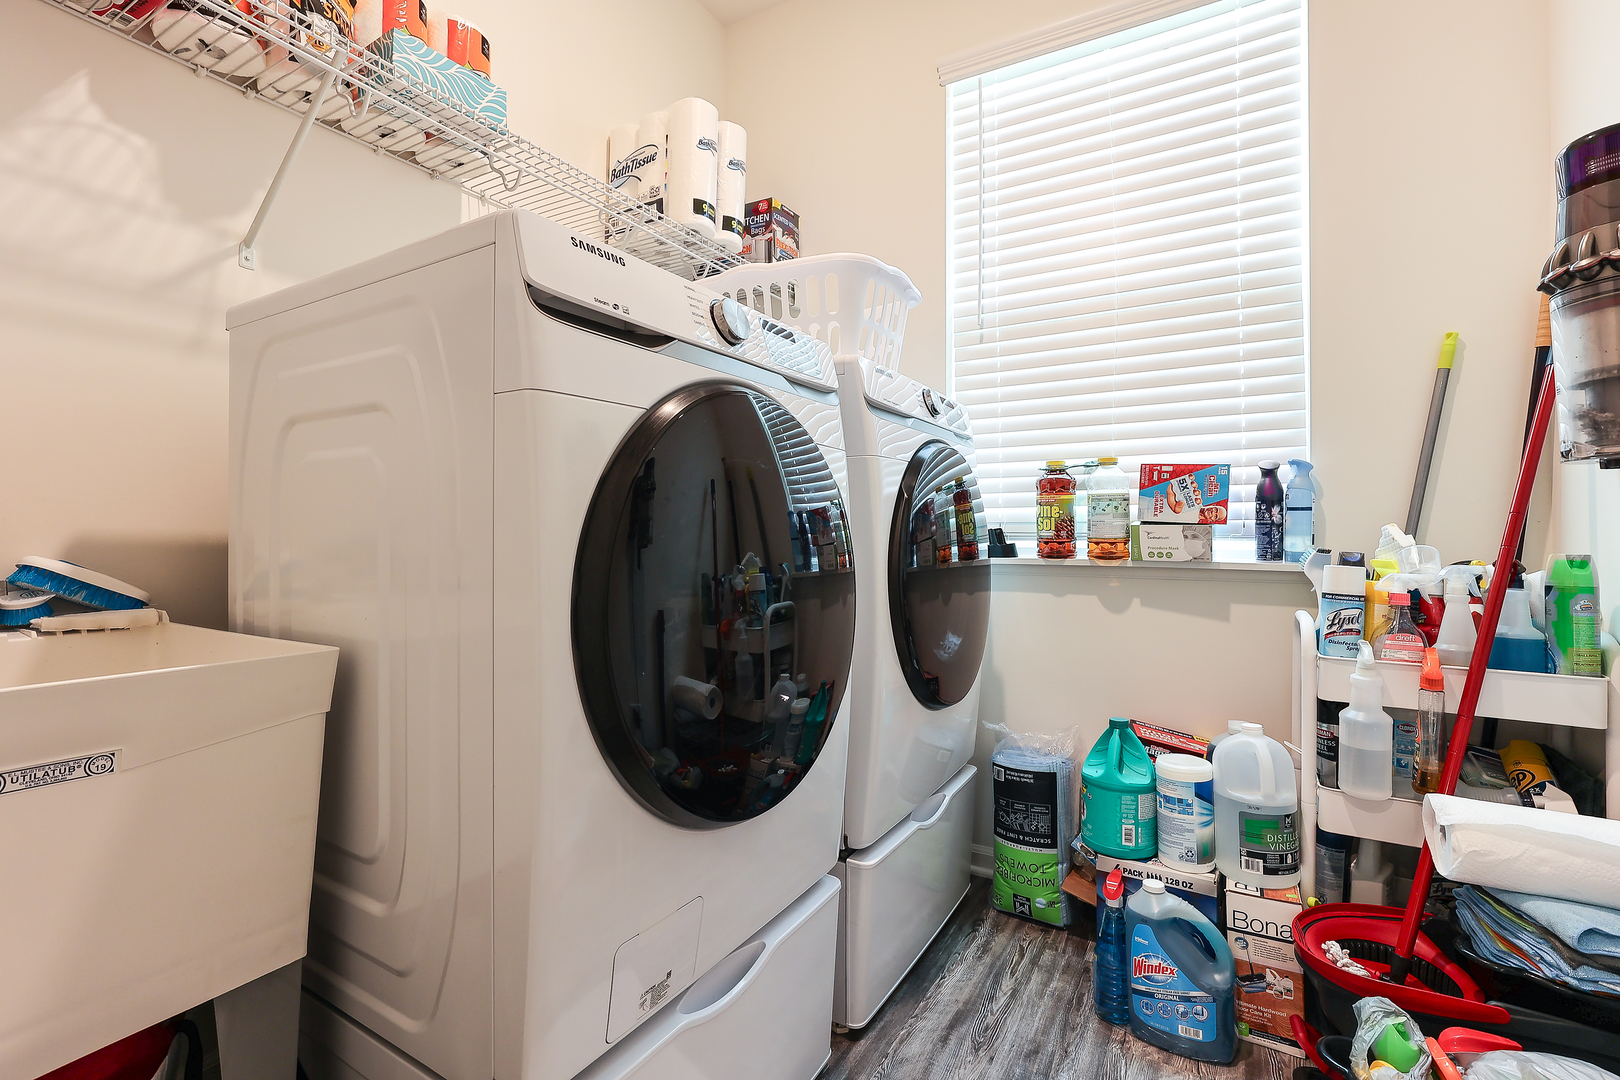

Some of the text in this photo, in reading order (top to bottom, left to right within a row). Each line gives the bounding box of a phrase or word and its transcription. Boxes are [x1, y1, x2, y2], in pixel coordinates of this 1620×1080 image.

[745, 213, 770, 226] TCHEN
[570, 236, 626, 267] SAMSUNG
[1178, 477, 1190, 493] 5X
[1207, 475, 1217, 498] Clean
[1038, 518, 1056, 531] Sol
[1326, 610, 1363, 632] Lysol
[1328, 639, 1359, 647] Disinfecta
[1395, 634, 1416, 642] dreft
[94, 763, 106, 772] 19
[10, 765, 76, 784] UTILATUB
[1007, 831, 1018, 839] LINT
[1024, 836, 1052, 844] SCRATCH
[1267, 830, 1299, 842] DISTILLE
[1269, 839, 1299, 851] VINEGA
[1000, 853, 1047, 874] TOWELS
[995, 864, 1056, 888] MICROFIBER
[1122, 867, 1144, 879] PACK
[1164, 876, 1180, 887] 128
[1181, 880, 1194, 890] OZ
[1233, 910, 1293, 940] Bona
[1132, 956, 1178, 978] Windex
[1154, 993, 1180, 1002] ORIGINAL
[1249, 1008, 1263, 1017] Care
[1258, 1005, 1287, 1018] Hardwood
